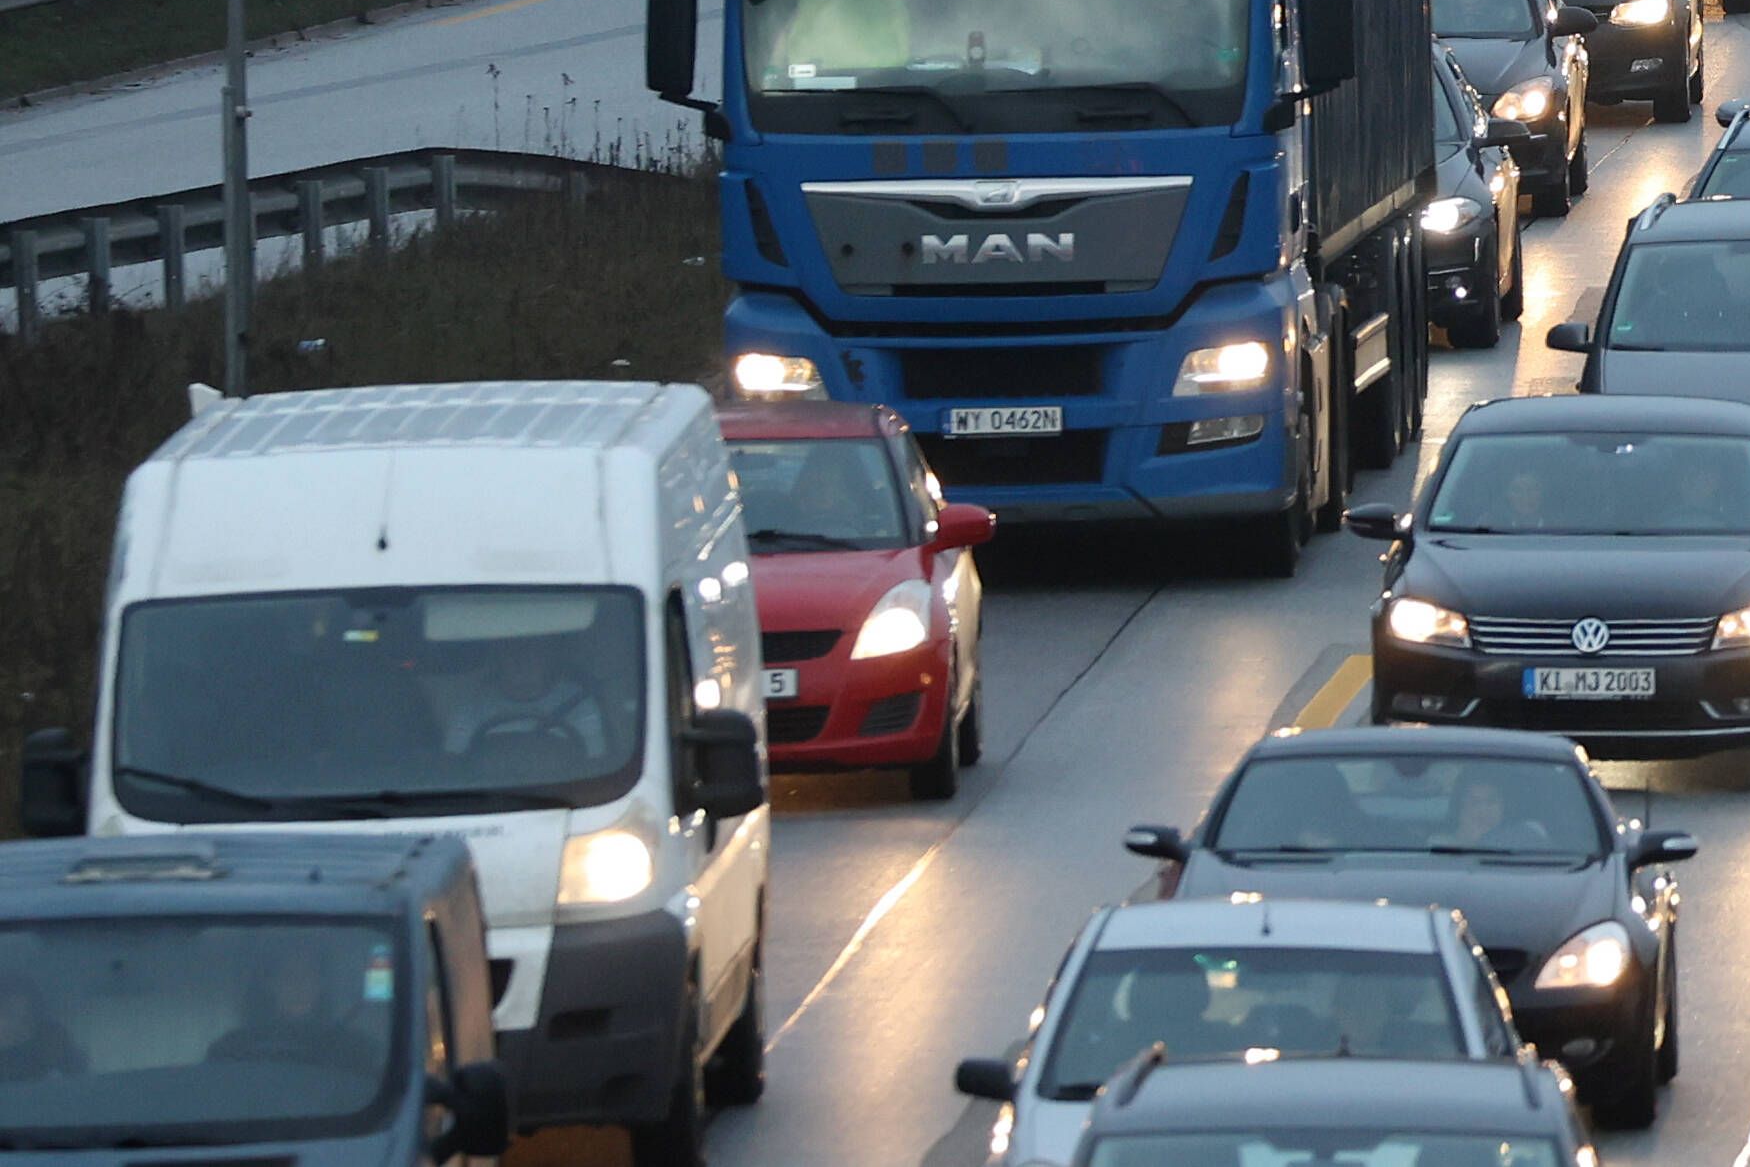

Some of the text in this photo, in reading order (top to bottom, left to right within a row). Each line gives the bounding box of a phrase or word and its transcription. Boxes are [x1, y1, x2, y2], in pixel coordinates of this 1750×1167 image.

[921, 233, 1074, 264] MAN
[956, 411, 981, 431] WY
[770, 672, 783, 694] 5
[1540, 671, 1651, 692] KI MJ 2003
